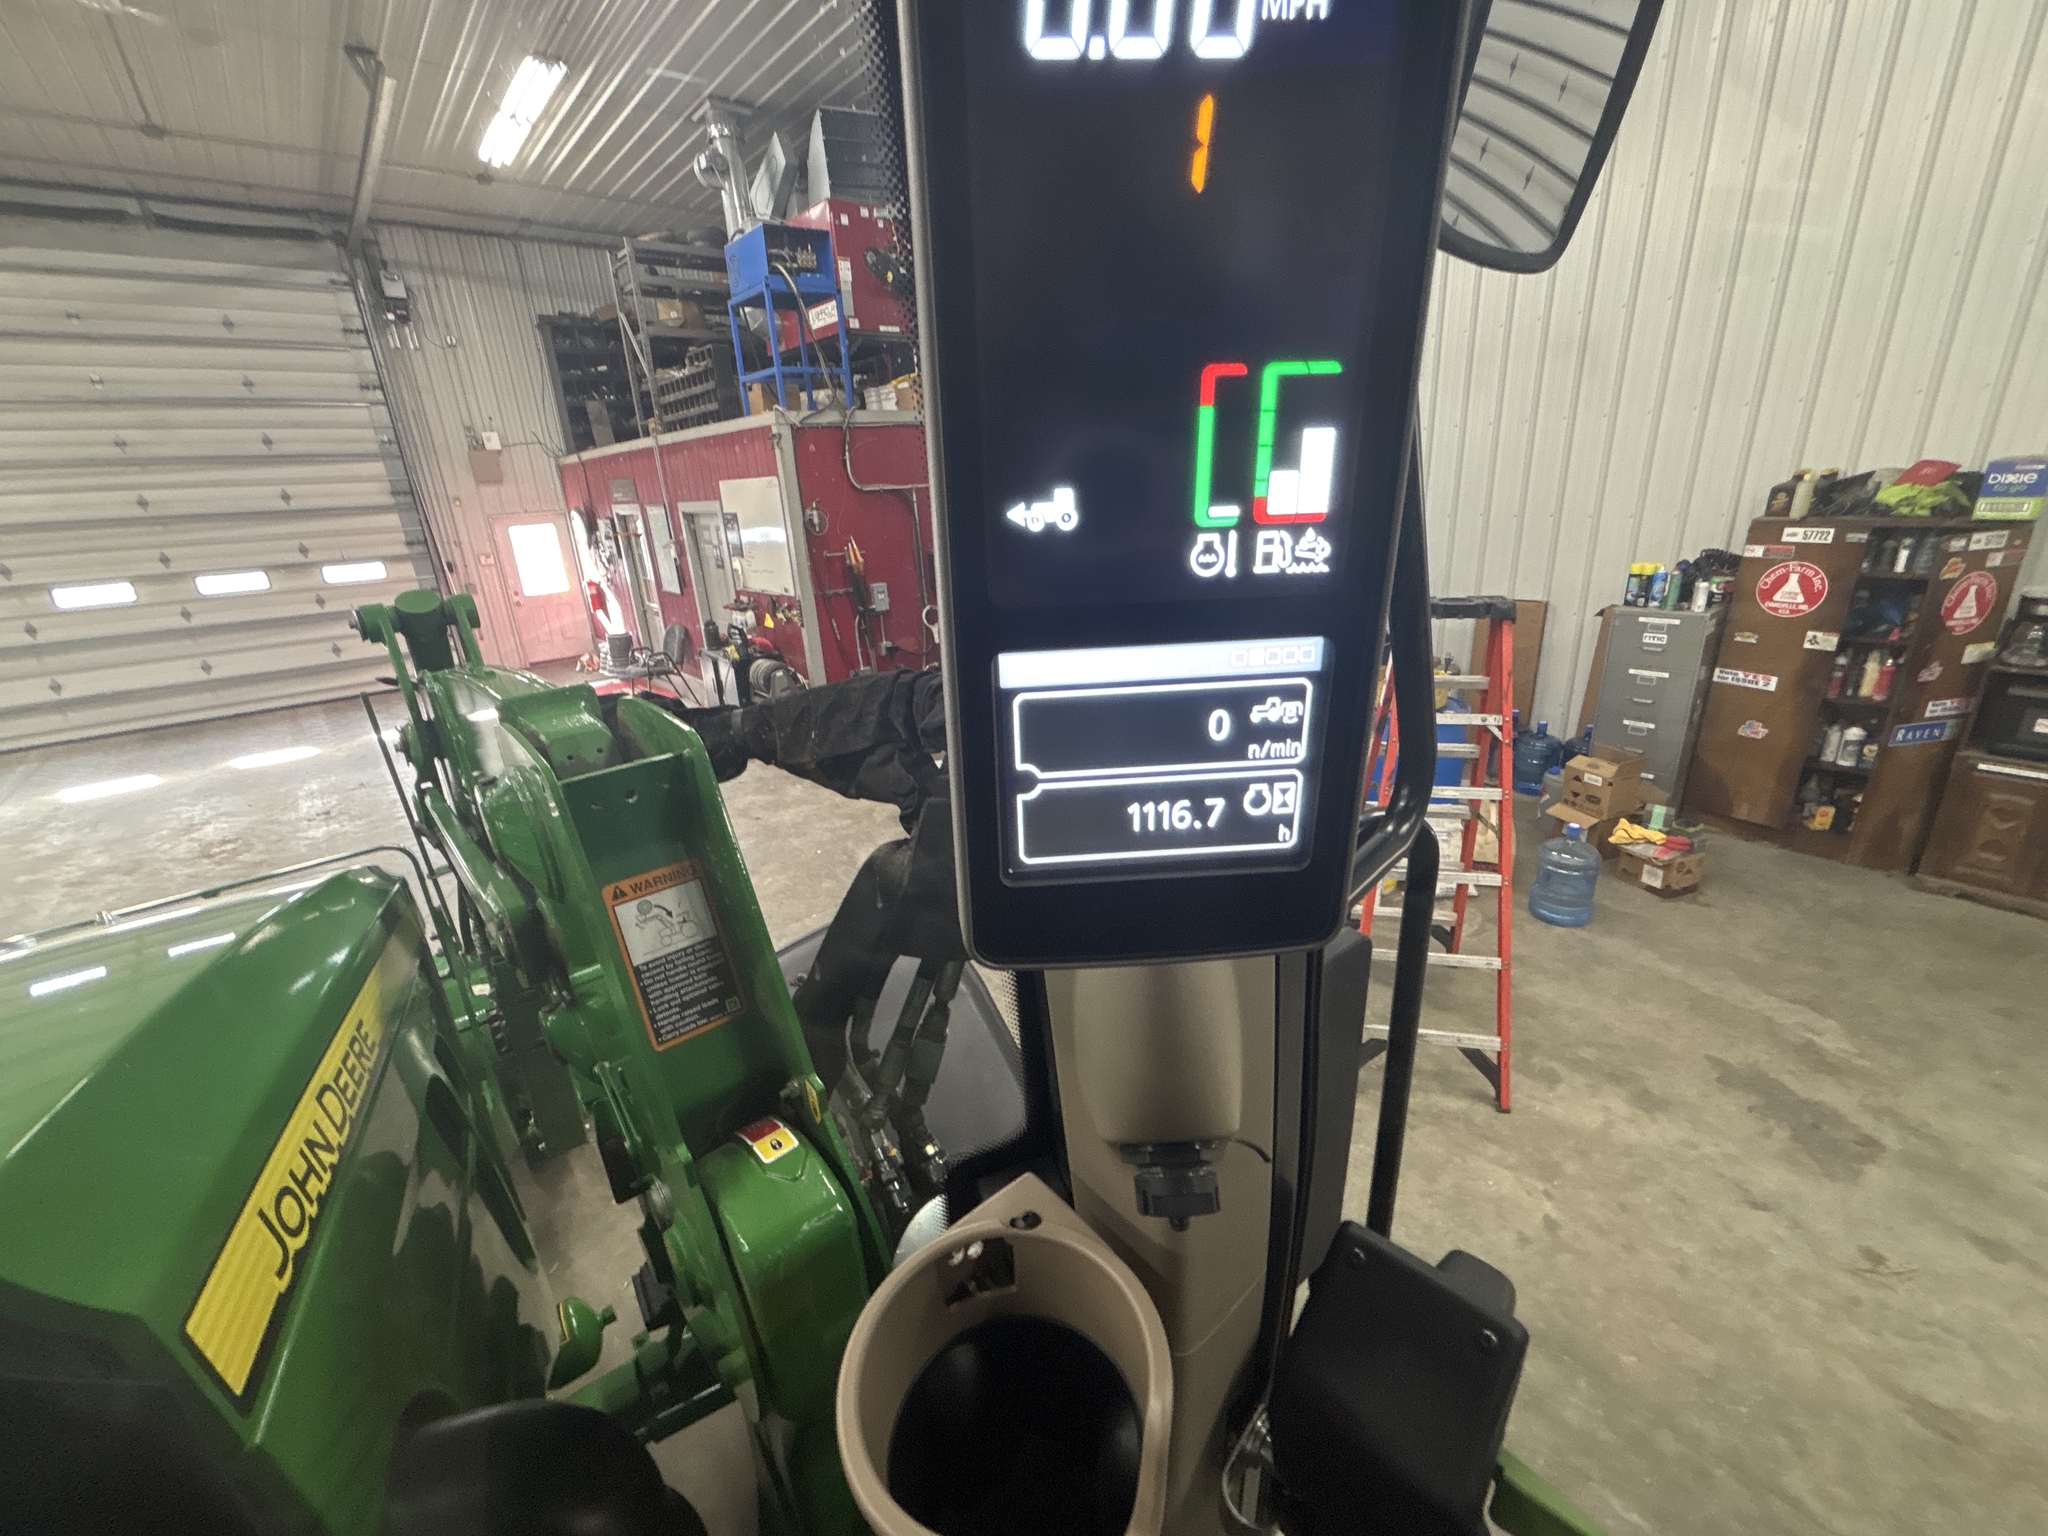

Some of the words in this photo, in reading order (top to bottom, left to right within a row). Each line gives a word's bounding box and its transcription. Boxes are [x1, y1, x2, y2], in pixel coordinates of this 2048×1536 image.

[1261, 0, 1329, 21] MPH
[1802, 529, 1831, 541] 57722
[1208, 708, 1231, 741] 0
[1894, 728, 1940, 741] RAVEN
[1247, 738, 1302, 759] n/min
[1127, 797, 1226, 832] 1116.7
[1277, 823, 1292, 842] h
[257, 1120, 336, 1280] JOHN
[316, 1018, 376, 1136] DEERE
